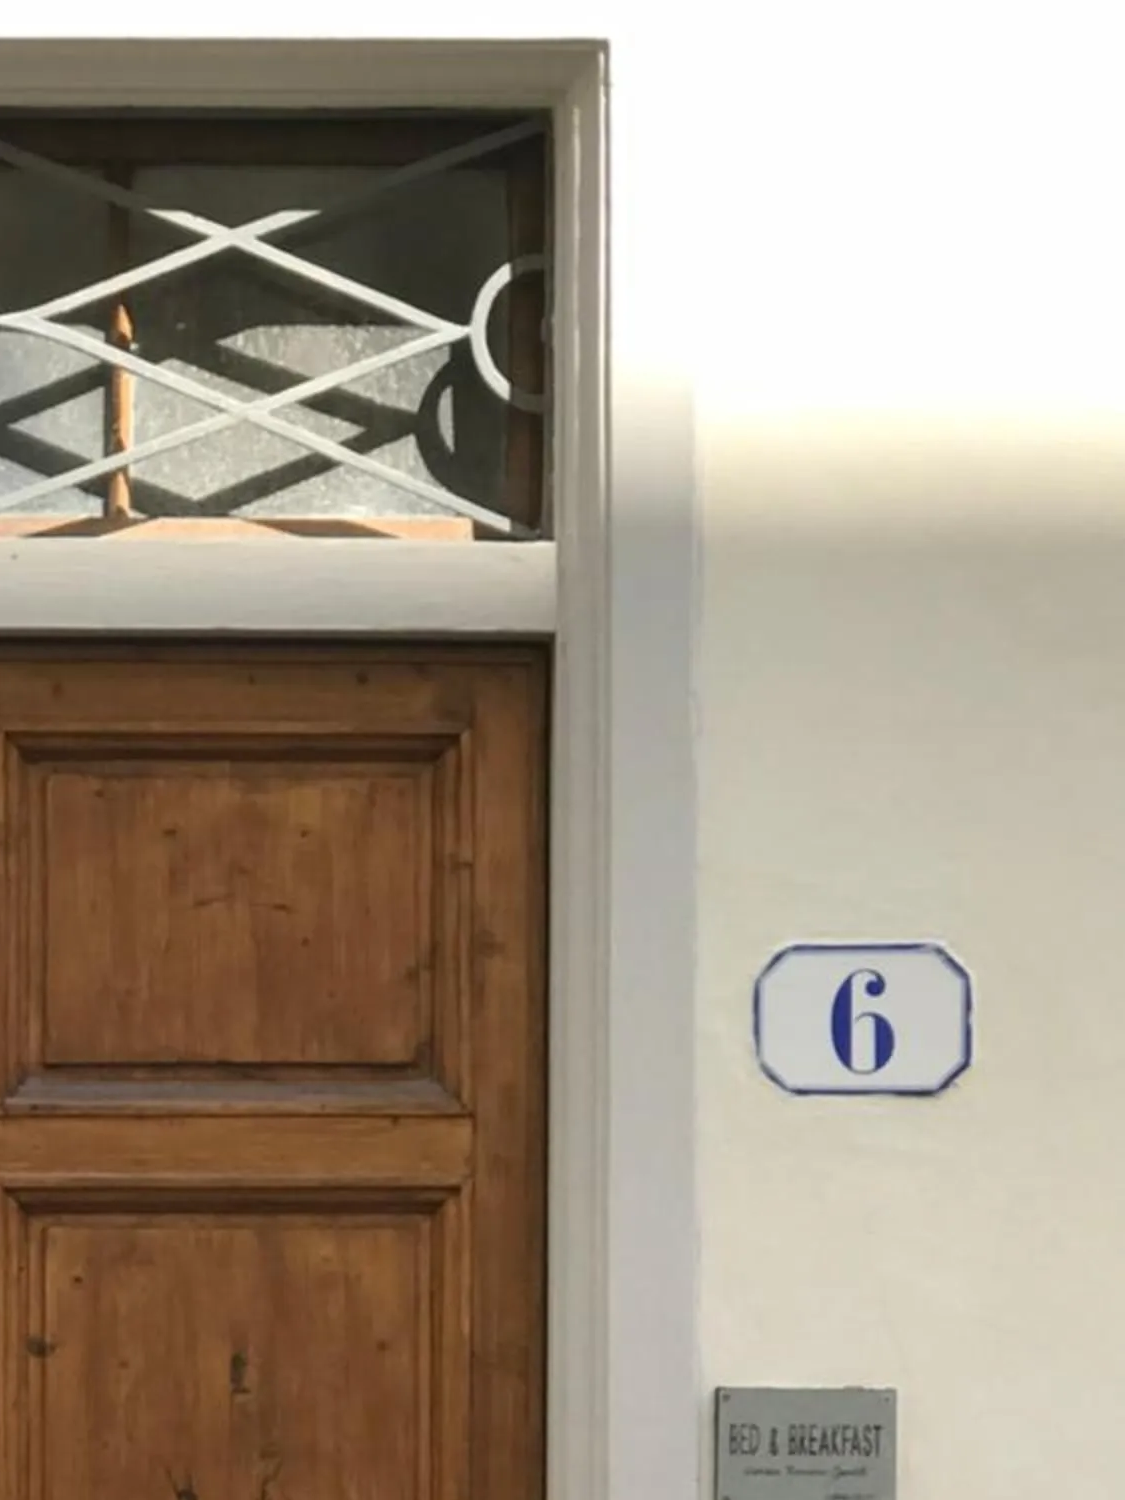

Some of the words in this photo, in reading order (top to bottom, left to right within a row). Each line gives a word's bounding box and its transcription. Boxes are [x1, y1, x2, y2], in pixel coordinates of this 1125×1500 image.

[830, 968, 895, 1075] 6
[729, 1423, 761, 1456] BED
[769, 1426, 779, 1456] &
[787, 1423, 883, 1457] BREAKFAST
